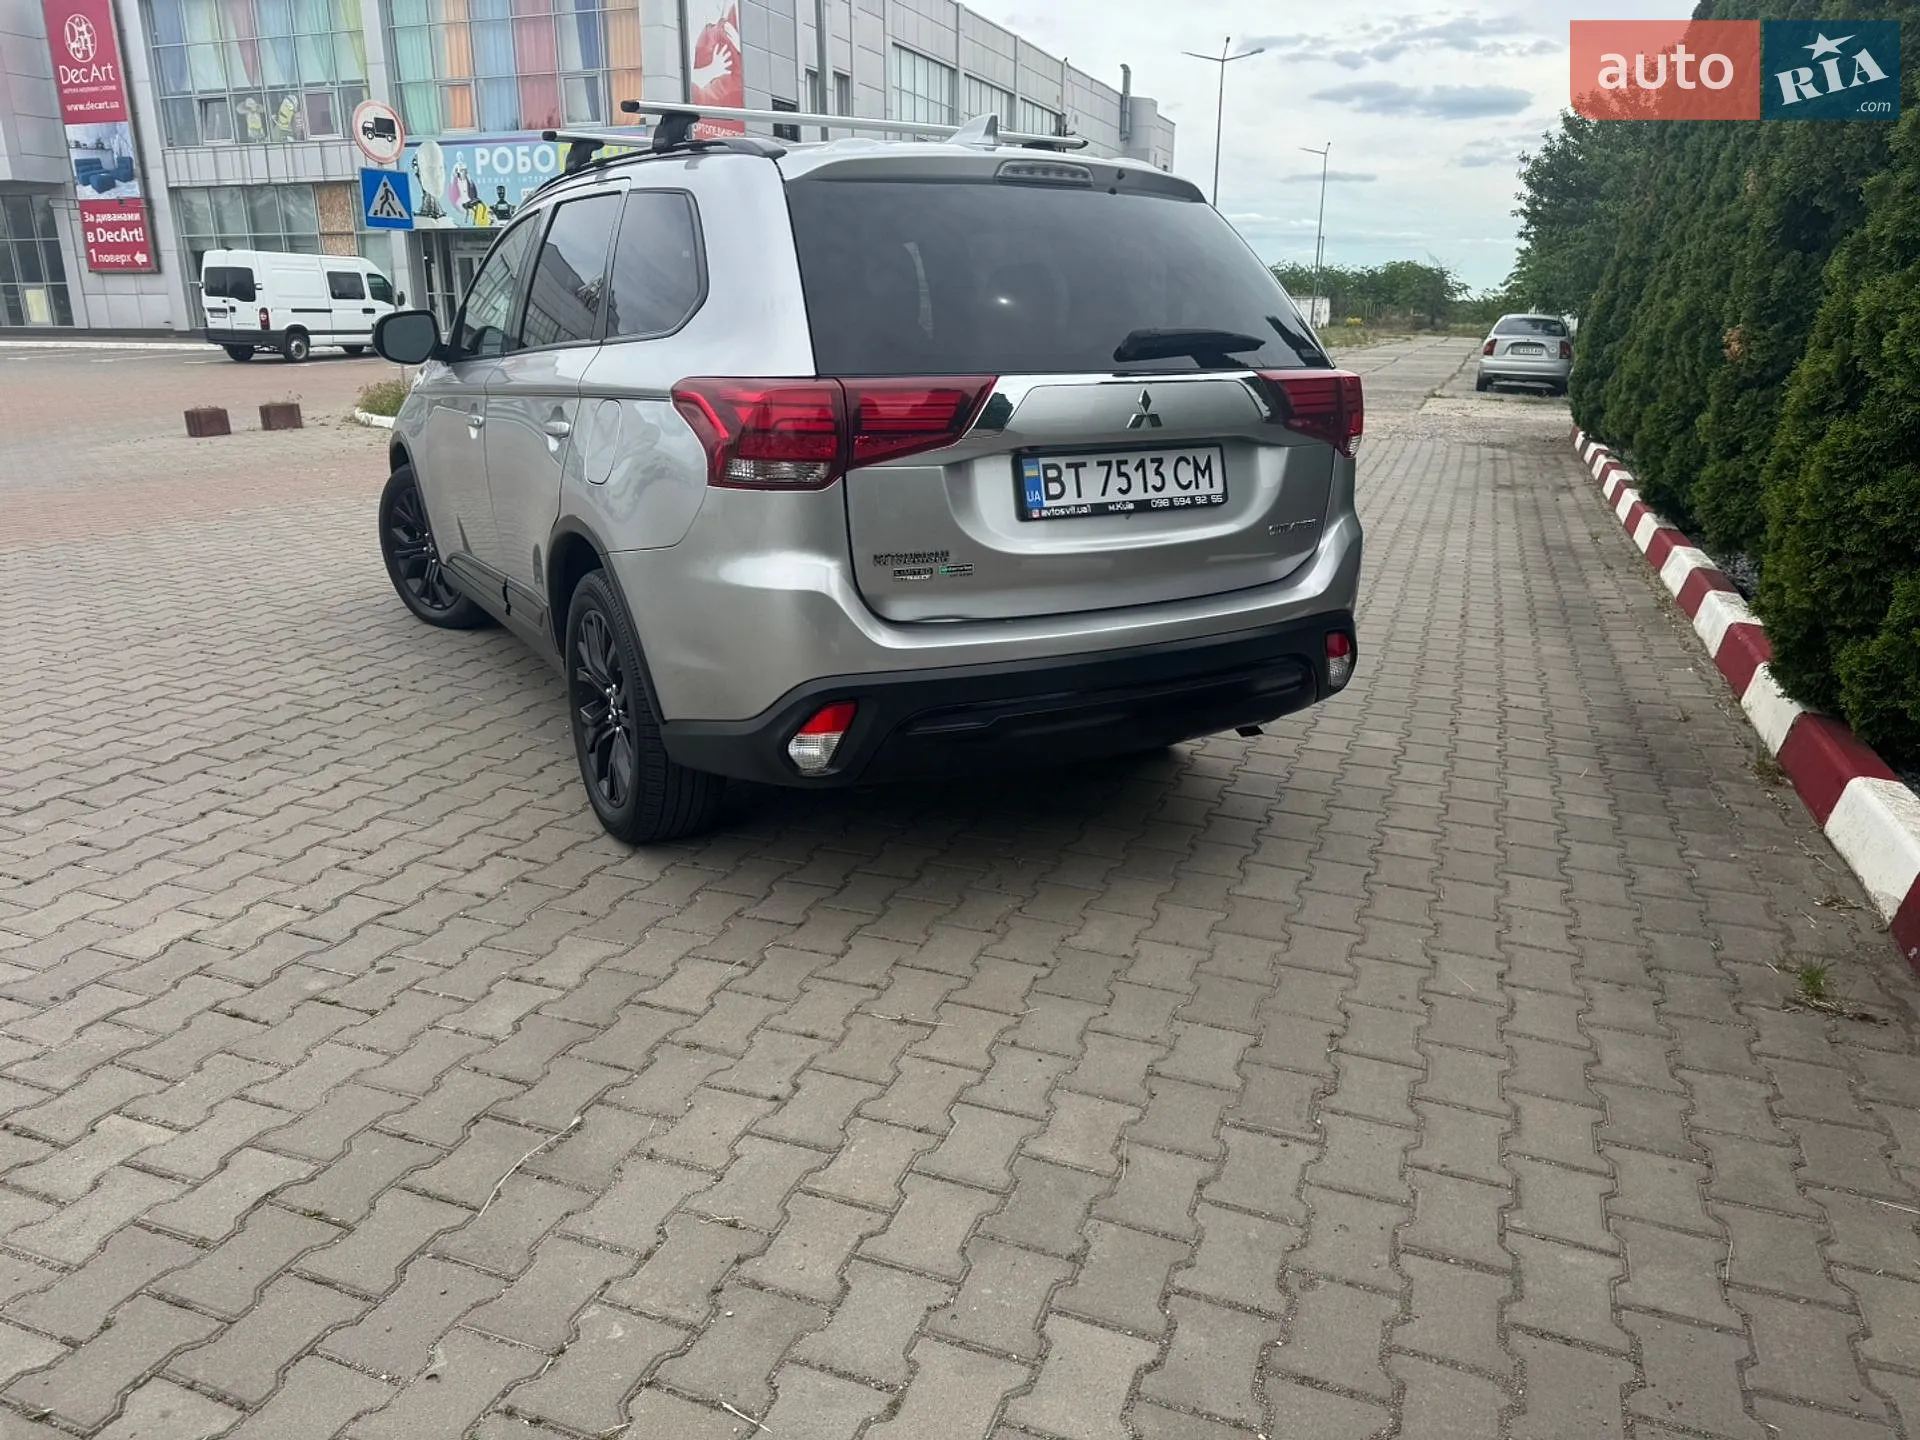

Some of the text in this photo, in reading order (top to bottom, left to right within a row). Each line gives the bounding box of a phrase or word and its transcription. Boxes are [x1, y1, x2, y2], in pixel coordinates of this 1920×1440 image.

[83, 211, 141, 225] За диванами
[96, 226, 144, 243] DecArt!
[89, 248, 132, 266] 1 поверх
[1041, 454, 1215, 501] BT 7513 CM
[1026, 490, 1042, 502] UA
